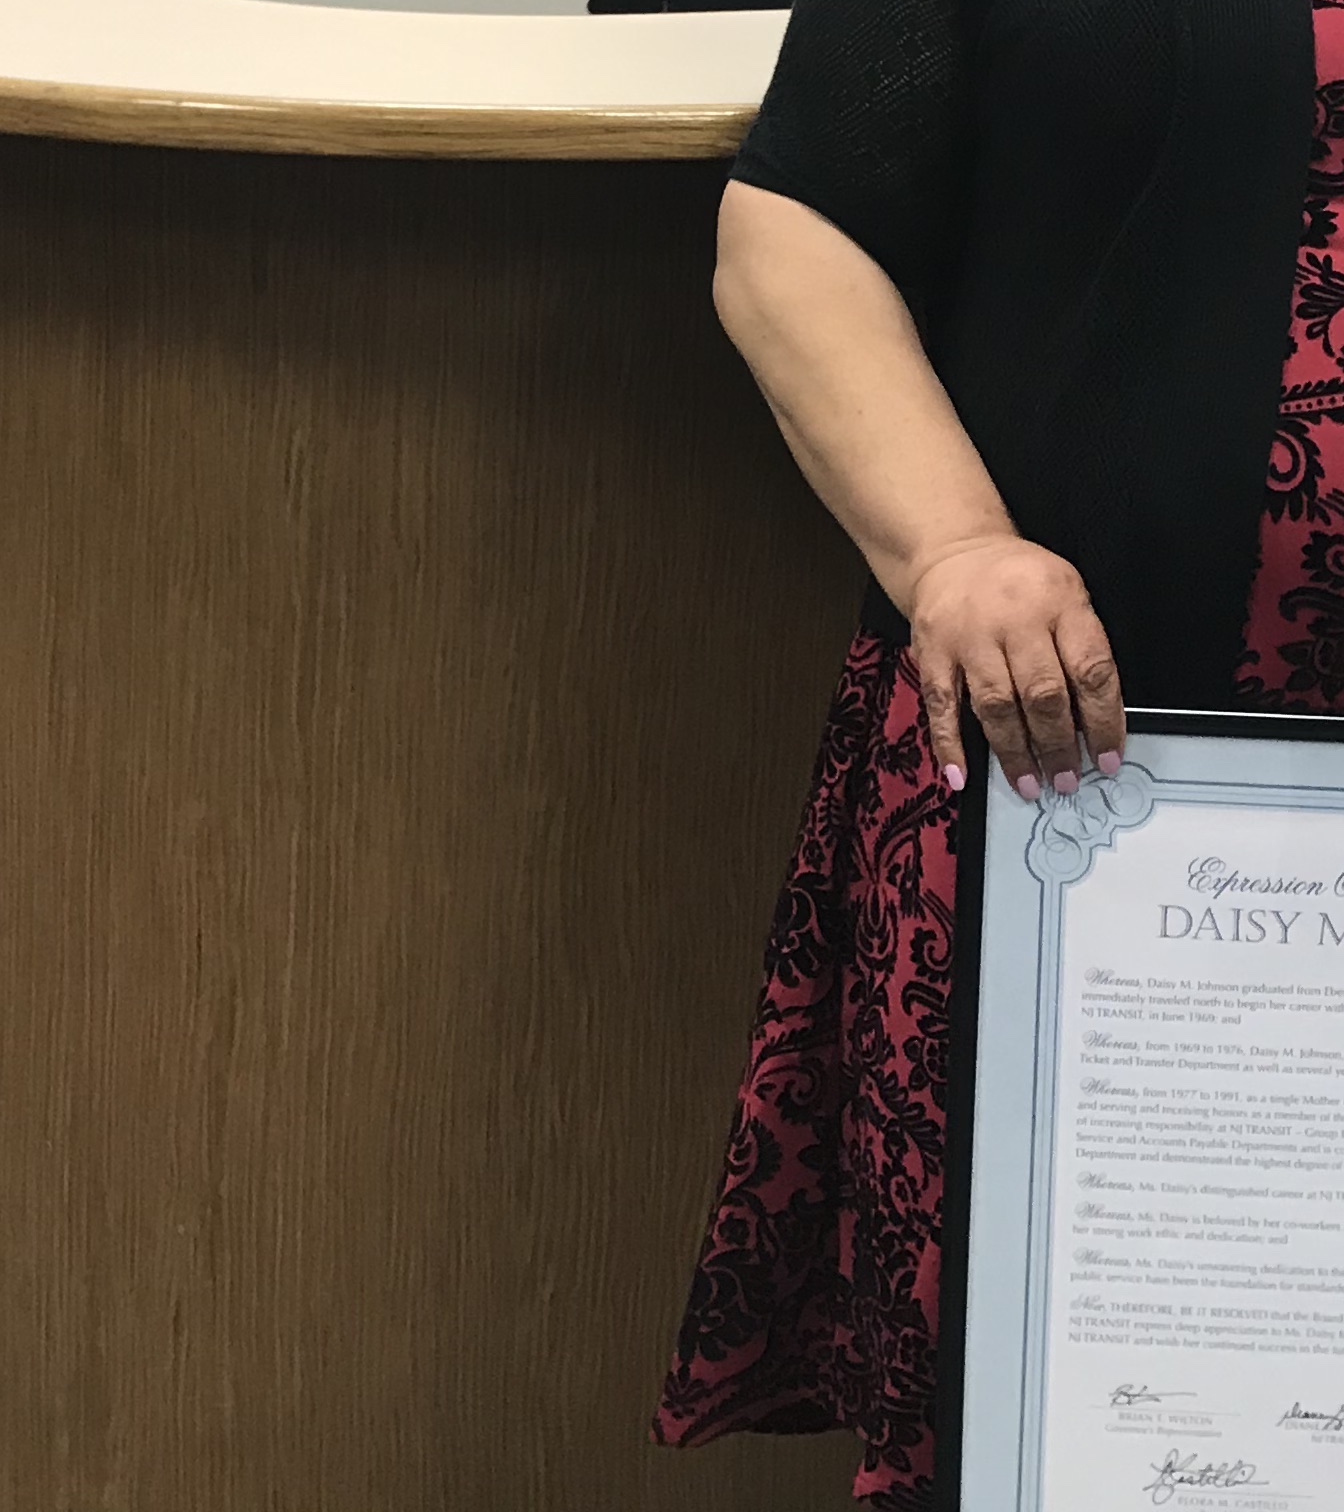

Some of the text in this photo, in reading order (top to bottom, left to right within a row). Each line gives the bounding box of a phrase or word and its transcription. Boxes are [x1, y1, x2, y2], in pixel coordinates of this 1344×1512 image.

[1188, 857, 1327, 899] Expression
[1157, 904, 1303, 944] DAISY
[1221, 1014, 1241, 1025] and
[1112, 1056, 1133, 1067] and
[1077, 1100, 1097, 1111] and
[1139, 1103, 1160, 1114] and
